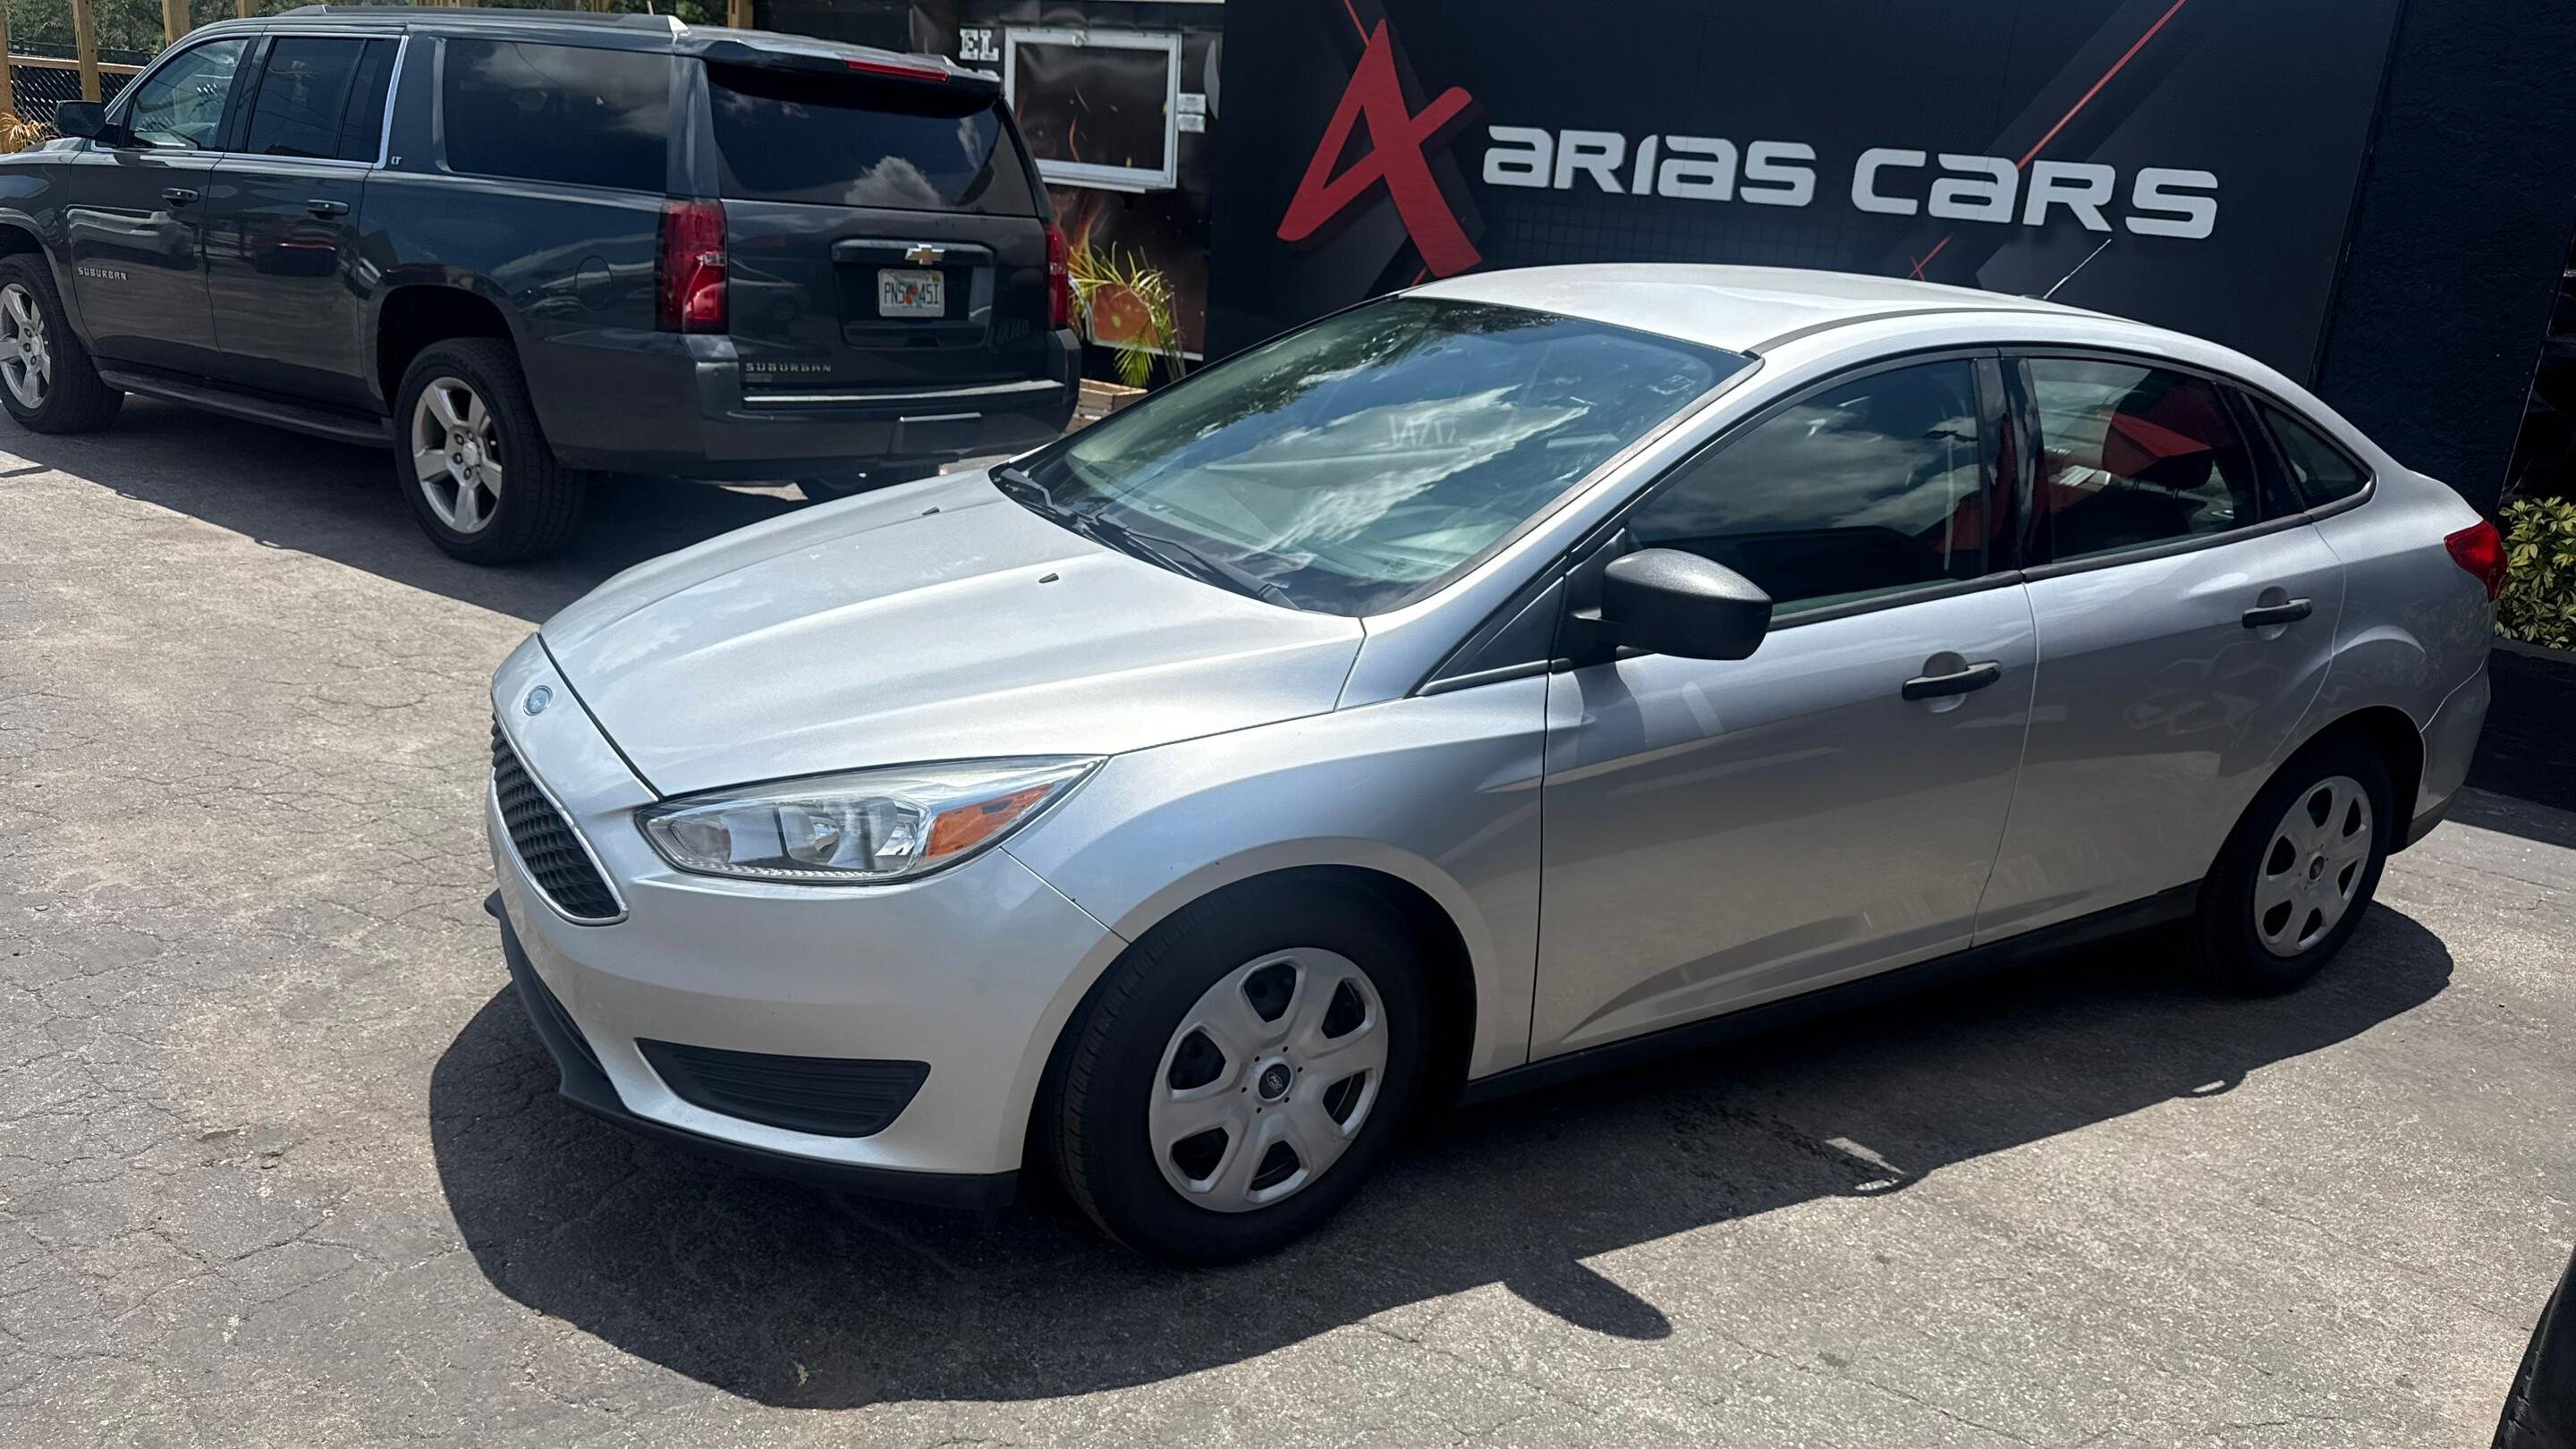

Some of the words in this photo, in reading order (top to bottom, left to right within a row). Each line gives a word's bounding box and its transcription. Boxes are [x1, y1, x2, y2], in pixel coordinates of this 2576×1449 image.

[959, 29, 999, 61] EL
[78, 267, 127, 281] SUBURBAN
[745, 362, 831, 372] SUBURBAN
